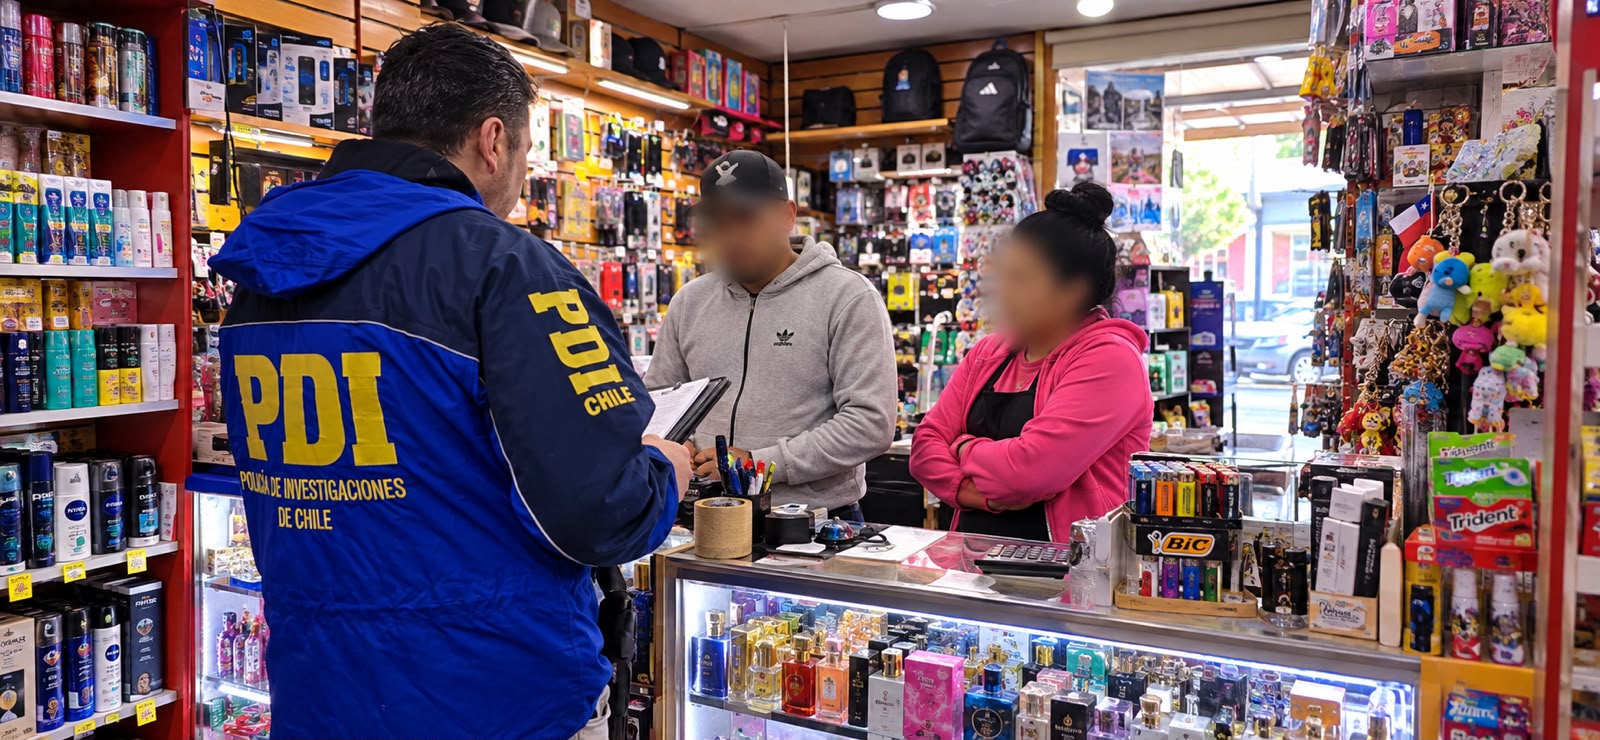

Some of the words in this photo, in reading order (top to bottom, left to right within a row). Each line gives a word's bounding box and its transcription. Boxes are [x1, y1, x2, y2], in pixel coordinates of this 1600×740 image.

[528, 288, 623, 395] PDI
[234, 352, 398, 467] PDI
[584, 386, 636, 416] CHILE
[270, 477, 282, 498] DE
[284, 477, 407, 501] INVESTIGACIONES
[278, 506, 293, 528] DE
[295, 508, 333, 530] CHILE
[1449, 505, 1517, 530] Trident
